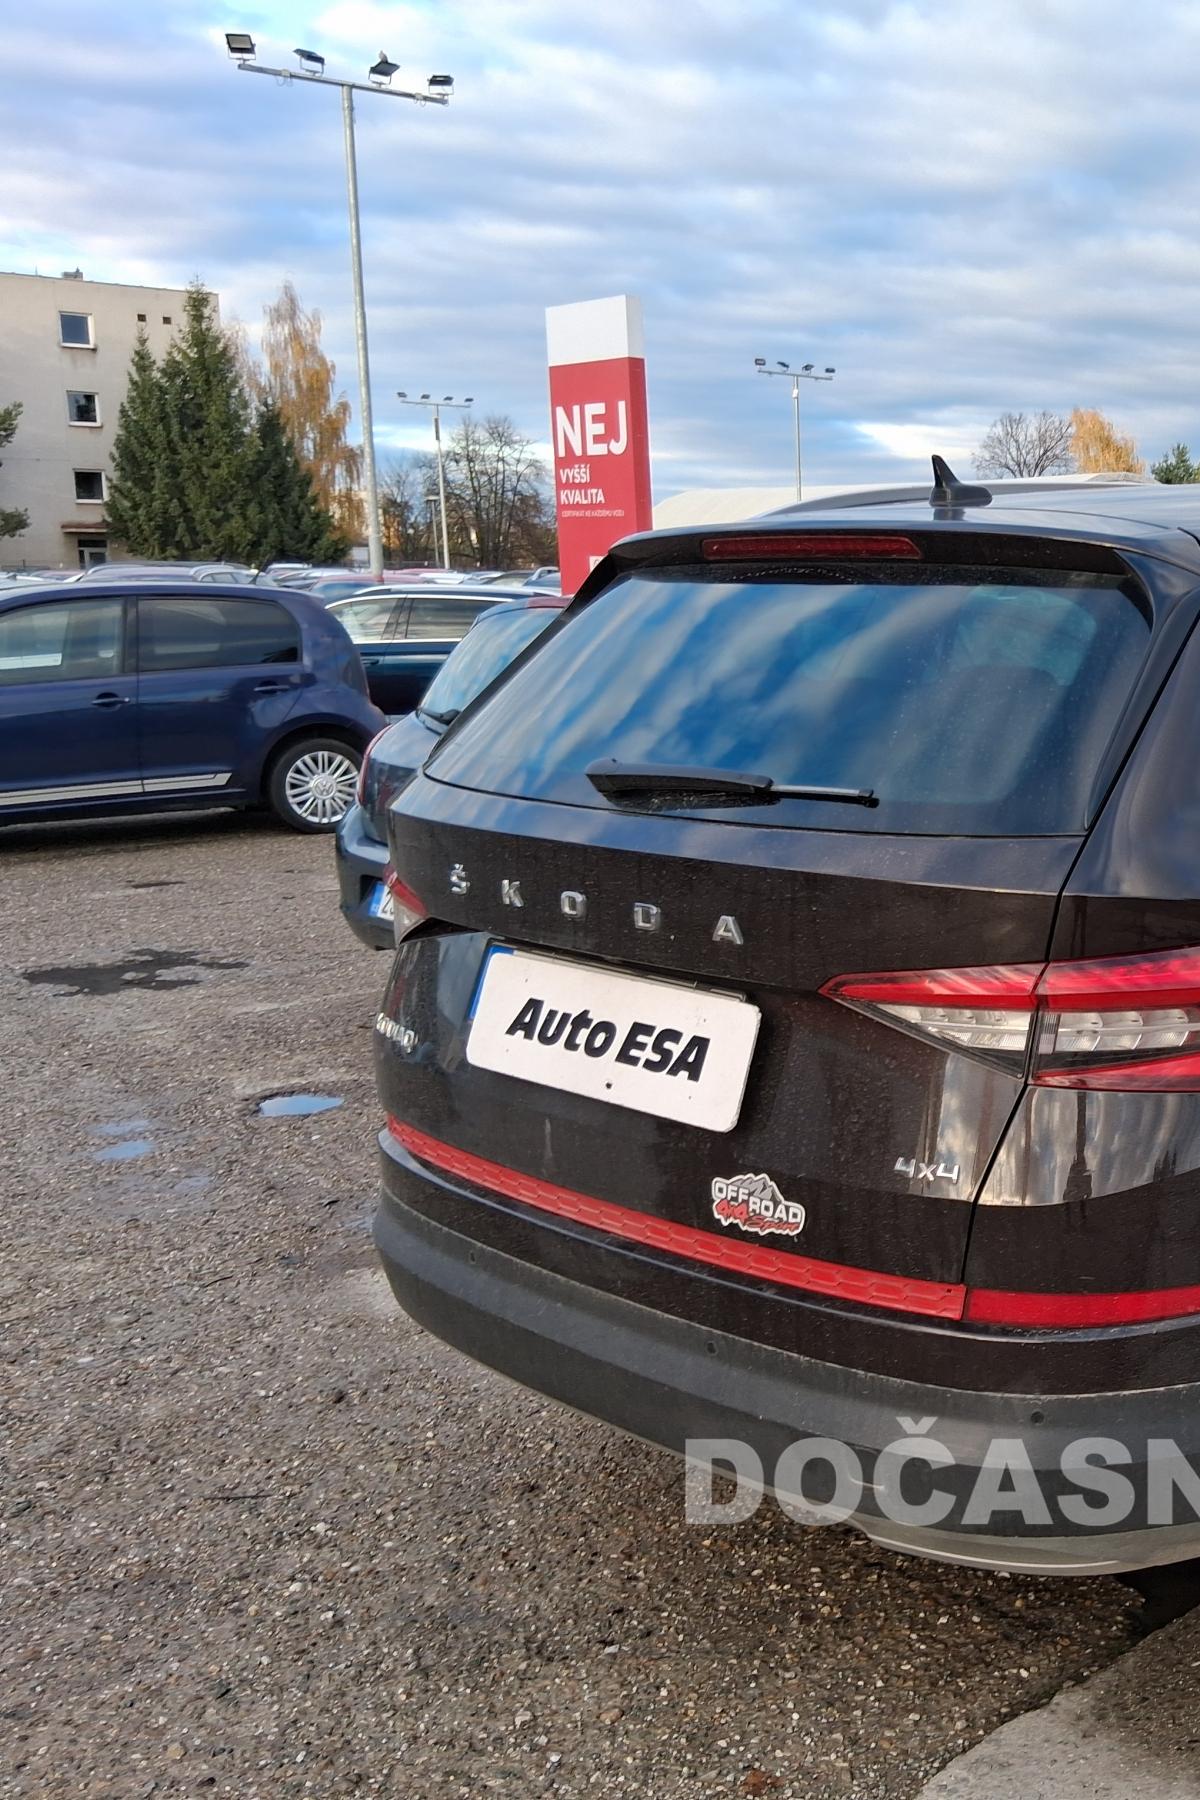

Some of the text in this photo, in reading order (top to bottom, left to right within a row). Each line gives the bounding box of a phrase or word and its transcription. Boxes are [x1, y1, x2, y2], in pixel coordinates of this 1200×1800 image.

[556, 400, 628, 458] NEJ
[560, 463, 591, 484] VYŠŠÍ
[560, 488, 605, 505] KVALITA
[449, 863, 744, 945] ŠKODA
[505, 997, 711, 1083] Auto ESA
[894, 1156, 960, 1184] 4x4
